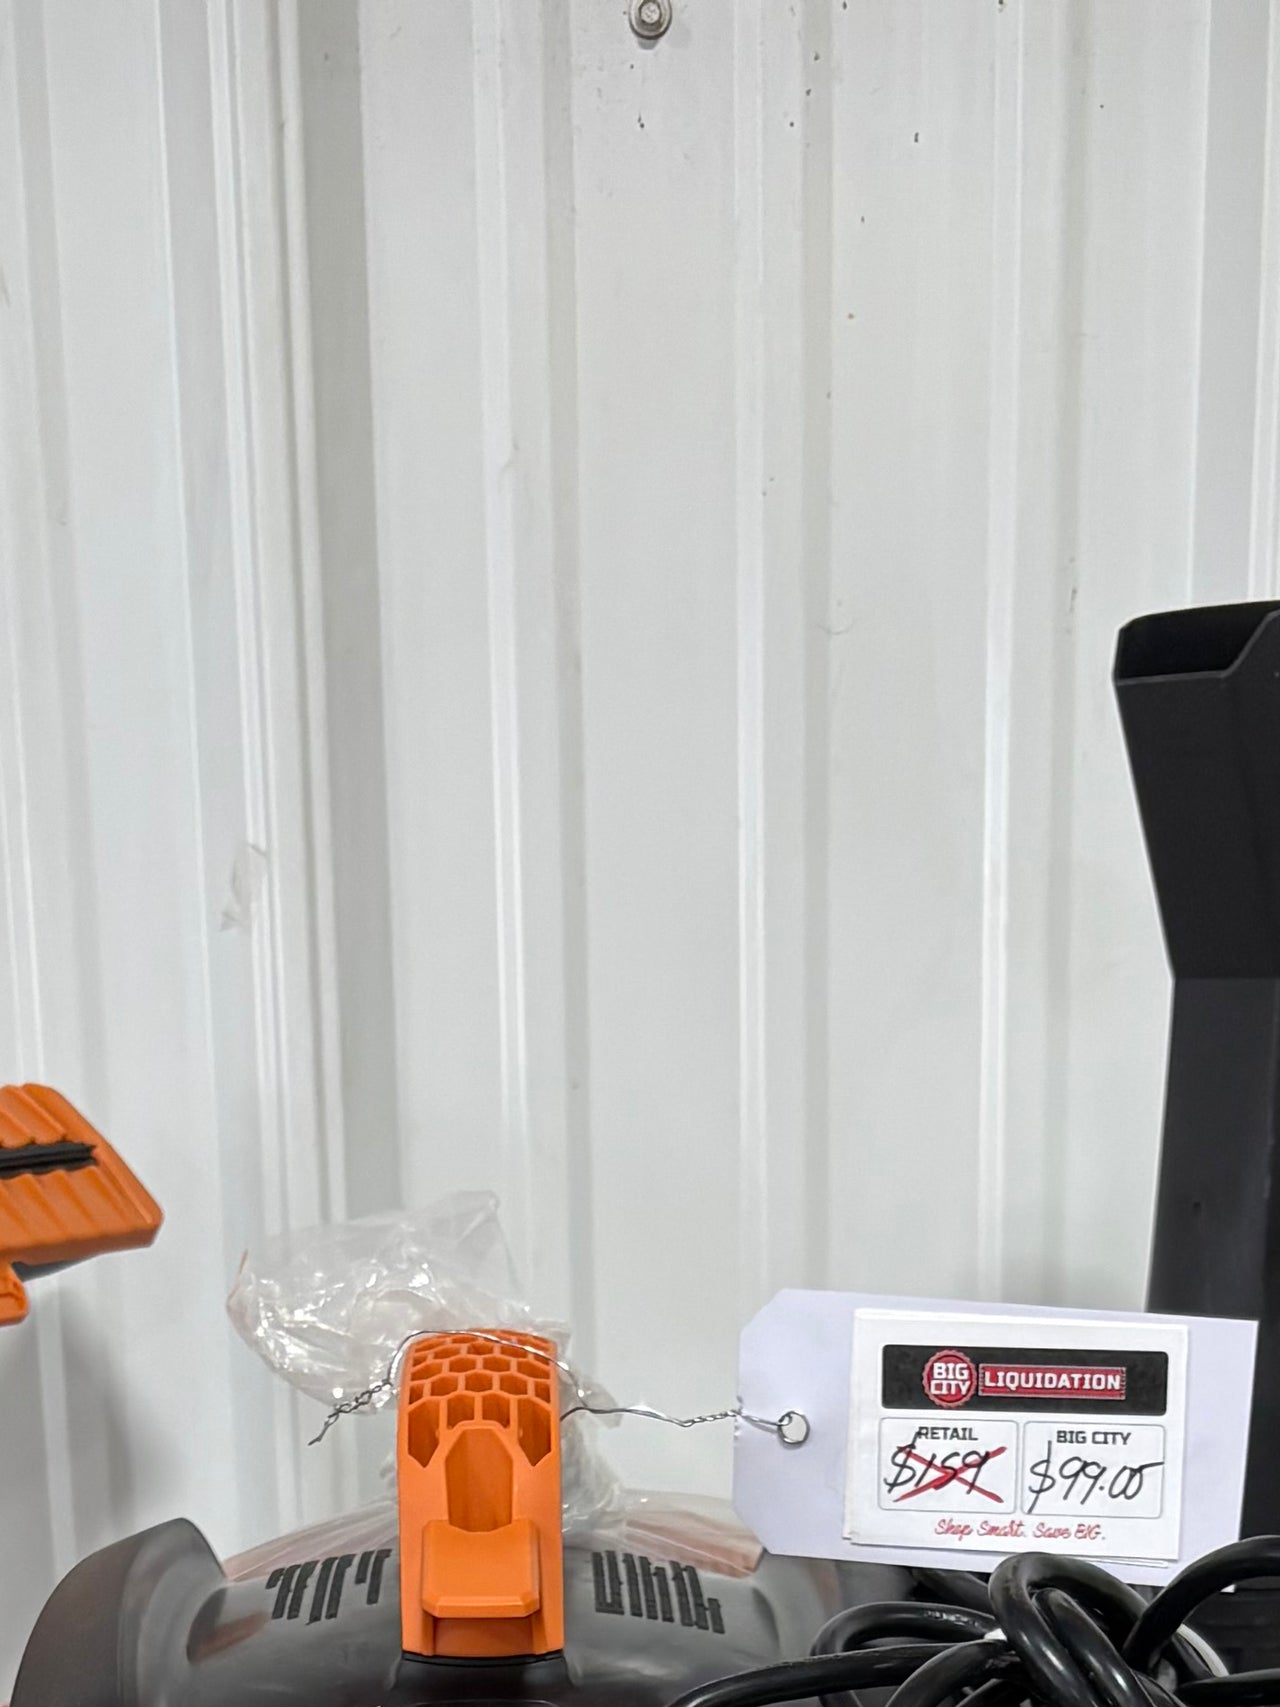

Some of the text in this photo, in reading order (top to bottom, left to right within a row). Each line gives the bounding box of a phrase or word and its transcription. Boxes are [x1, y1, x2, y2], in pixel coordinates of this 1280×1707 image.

[933, 1362, 969, 1380] BIG
[930, 1380, 970, 1396] CITY
[984, 1370, 1121, 1391] LIQUIDATION
[918, 1426, 978, 1442] RETAIL
[1056, 1430, 1132, 1446] BIG CITY
[1027, 1441, 1165, 1514] $99.00
[934, 1519, 973, 1541] Shop
[1032, 1522, 1072, 1539] Save
